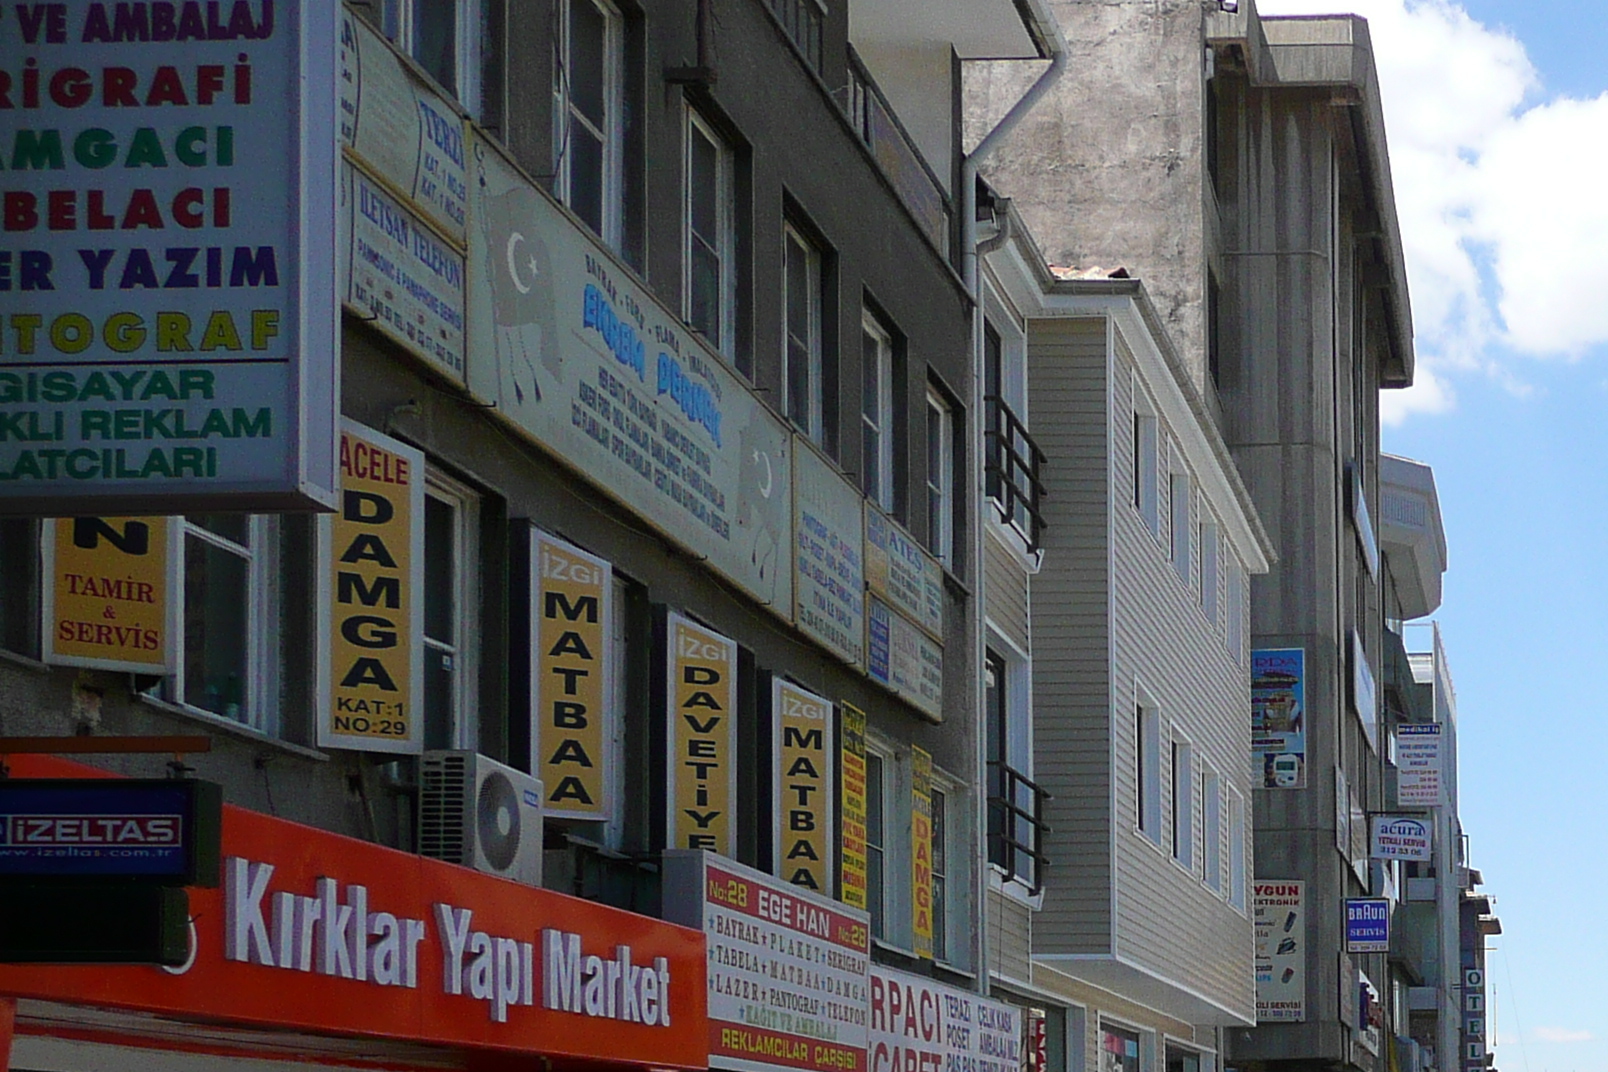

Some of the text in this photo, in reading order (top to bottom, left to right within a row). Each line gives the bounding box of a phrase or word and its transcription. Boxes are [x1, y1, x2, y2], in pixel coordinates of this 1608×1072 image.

[17, 0, 275, 44] VE AMBALAJ
[0, 126, 235, 170] MGACI
[78, 246, 280, 290] YAZIM
[0, 310, 281, 355] TOGRAF
[81, 407, 272, 440] REKLAM
[341, 434, 409, 487] ACELE
[64, 574, 155, 605] TAMİR
[337, 490, 401, 692] DAMGA
[58, 619, 160, 652] SERVİS
[544, 591, 598, 805] MATBAA
[682, 666, 723, 849] DAVETİYE
[784, 726, 823, 891] MATBAA
[1380, 822, 1422, 837] acura
[915, 816, 930, 932] DAMGA
[709, 880, 748, 908] No:28
[758, 890, 792, 926] EGE
[796, 905, 830, 939] HAN
[1349, 904, 1386, 921] BRAUN
[225, 855, 671, 1027] Kırklar Yapı Market
[716, 914, 760, 946] BAYRAK
[770, 932, 821, 965] PLAKET
[716, 946, 867, 1003] TABELA MATBAA DAMGA
[716, 974, 867, 1027] LAZER PANTOGRAF TELEFON
[870, 974, 942, 1045] RPACI
[1468, 970, 1481, 1058] OTEL
[721, 1028, 857, 1072] REKLAMCILAR ÇARŞISI
[947, 1023, 970, 1053] POŞET
